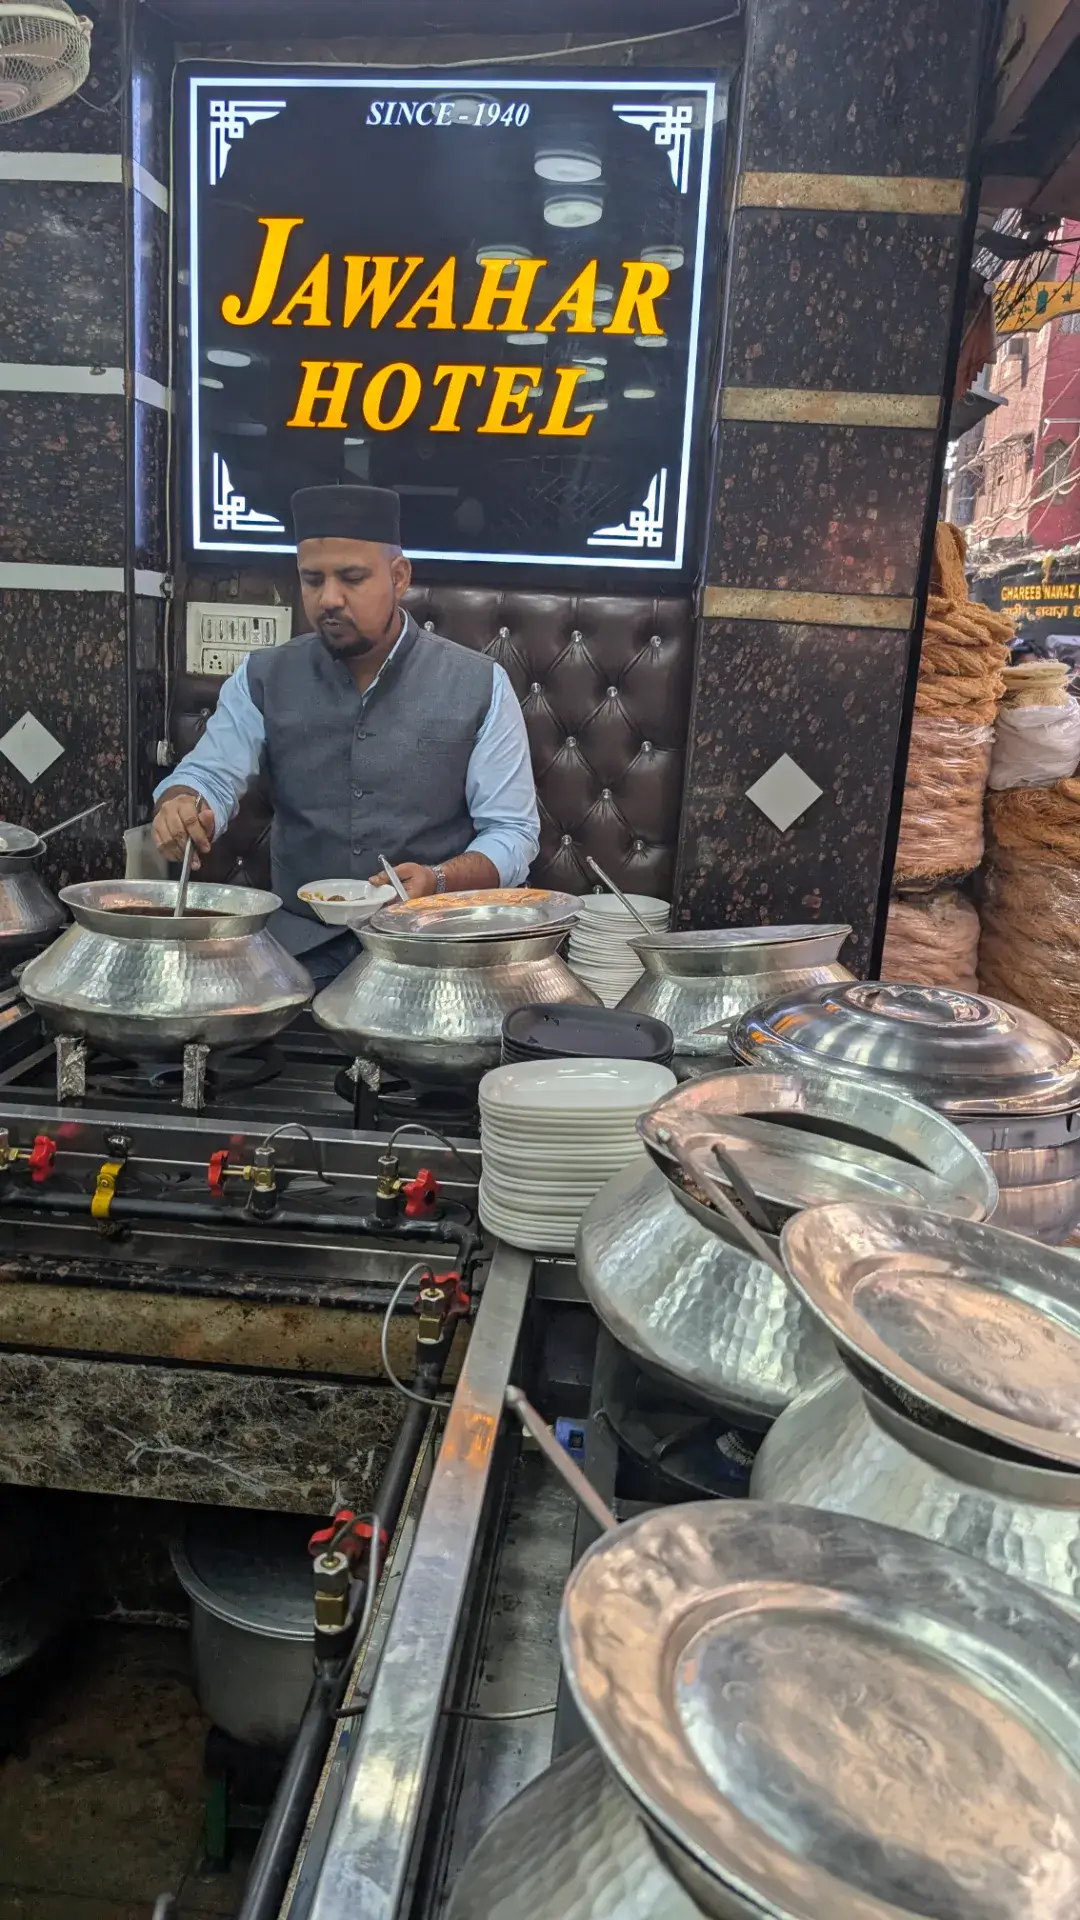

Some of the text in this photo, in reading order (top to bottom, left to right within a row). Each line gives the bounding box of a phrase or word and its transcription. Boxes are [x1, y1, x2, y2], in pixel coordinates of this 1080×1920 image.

[221, 217, 671, 336] JAWAHAR
[286, 361, 596, 437] HOTEL
[1001, 586, 1042, 601] GHAREEB
[1043, 584, 1076, 600] NAWAZ
